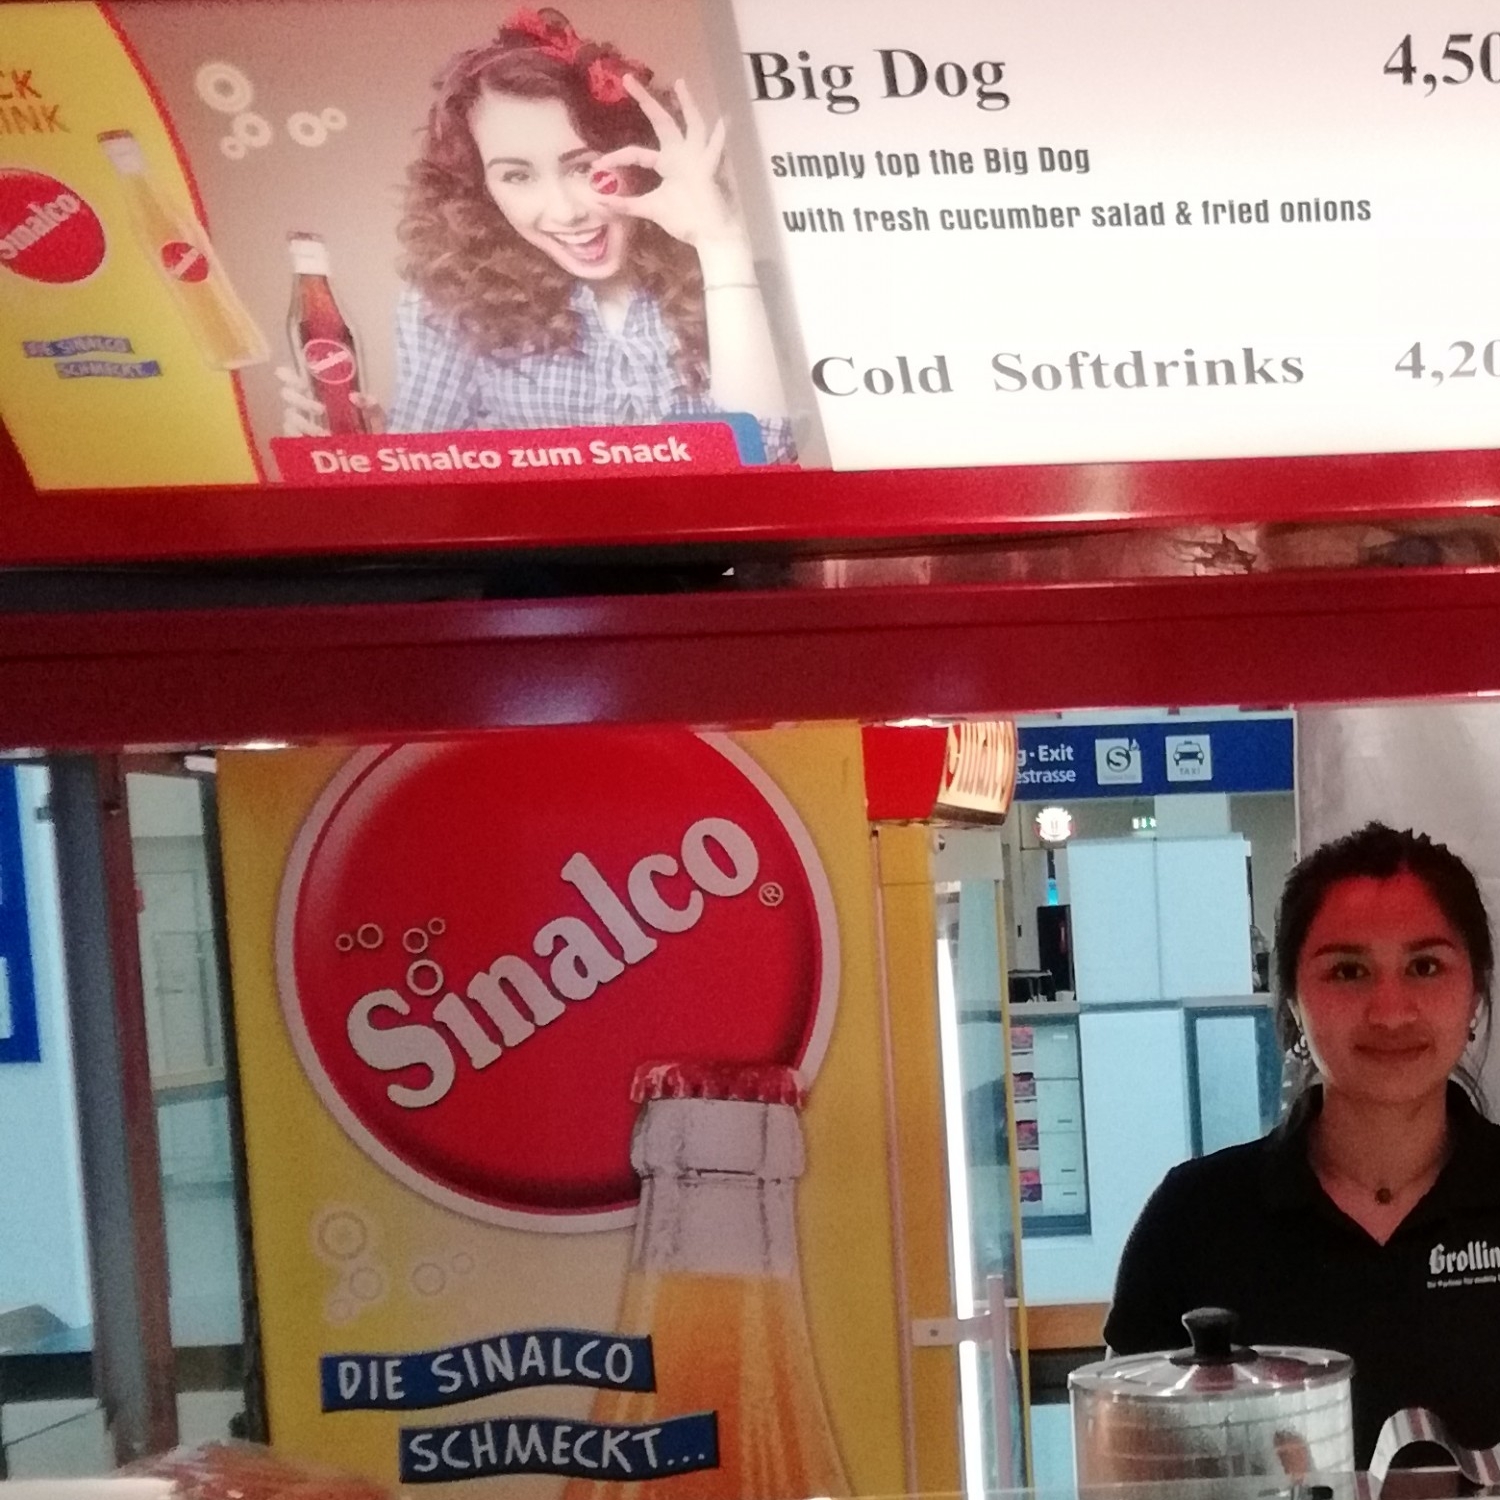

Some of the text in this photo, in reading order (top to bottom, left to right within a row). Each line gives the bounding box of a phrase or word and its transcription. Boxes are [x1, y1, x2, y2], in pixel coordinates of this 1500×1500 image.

[745, 49, 859, 114] Big
[876, 48, 1010, 111] Dog
[771, 145, 1091, 179] simply top the Big Dog
[783, 198, 1372, 233] with fresh cucumber salad & fried onions
[811, 355, 954, 397] Cold
[992, 347, 1305, 393] Softdrinks
[312, 436, 692, 473] Die Sinalco zum Snack
[1038, 744, 1075, 762] Exit
[346, 816, 761, 1108] Sinalco
[338, 1336, 635, 1401] DIE SINALCO
[408, 1414, 706, 1471] SCHMECKT...
